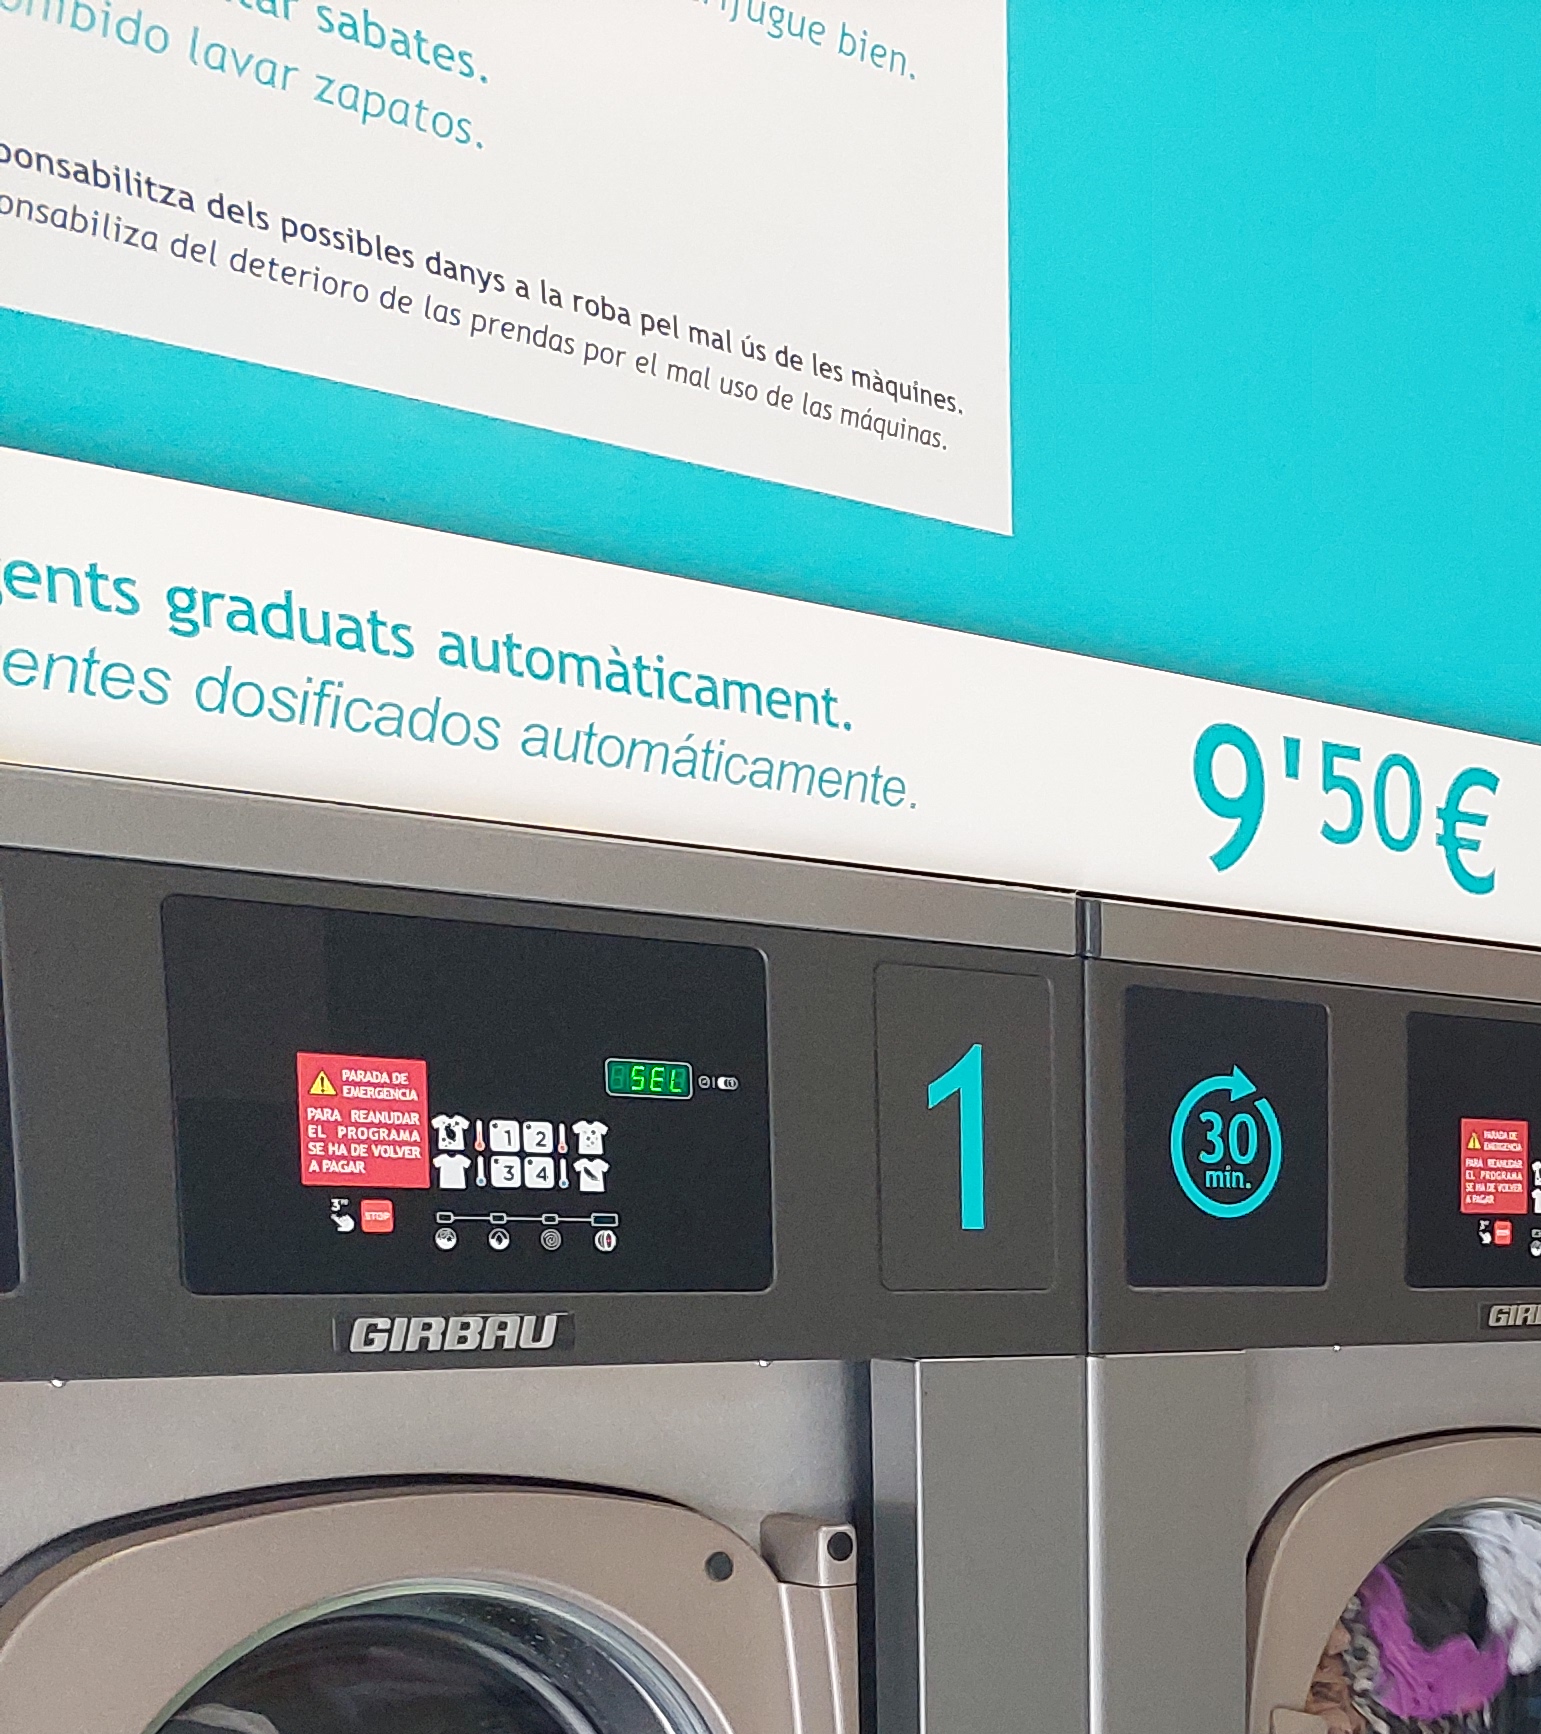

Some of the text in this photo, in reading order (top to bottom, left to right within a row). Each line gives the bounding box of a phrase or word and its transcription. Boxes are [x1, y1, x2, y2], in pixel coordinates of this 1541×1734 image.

[317, 4, 489, 83] sabates.
[838, 22, 915, 80] bien.
[190, 26, 299, 90] lavar
[314, 75, 483, 149] zapatos.
[208, 193, 269, 230] dels
[282, 217, 414, 268] possibles
[426, 252, 505, 293] danys
[516, 280, 530, 299] a
[541, 279, 563, 308] la
[574, 295, 631, 326] roba
[641, 314, 679, 339] pel
[689, 326, 731, 353] mal
[742, 335, 766, 361] ús
[776, 346, 803, 371] de
[813, 353, 842, 382] les
[852, 369, 962, 415] màquines.
[171, 234, 216, 266] del
[230, 248, 368, 302] deterioro
[380, 286, 412, 314] de
[425, 295, 460, 326] las
[470, 314, 574, 355] prendas
[584, 342, 626, 367] por
[636, 353, 656, 376] el
[667, 364, 710, 390] mal
[720, 377, 757, 401] uso
[767, 385, 793, 410] de
[803, 392, 832, 420] las
[841, 408, 946, 450] máquinas.
[0, 558, 851, 731] ents graduats automàticament.
[3, 647, 916, 809] entes dosificados automáticamente.
[1193, 722, 1501, 895] 9'50€
[342, 1070, 409, 1084] PARADA DE
[343, 1086, 418, 1101] EMERGENCIA
[630, 1066, 682, 1093] SEL
[307, 1108, 420, 1125] PARA REANUDAR
[308, 1125, 420, 1142] EL PROGRAMA
[927, 1043, 984, 1229] 1
[1199, 1112, 1257, 1164] 30
[308, 1142, 421, 1158] SE HA DE VOLVER
[309, 1160, 366, 1173] A PAGAR
[1206, 1166, 1251, 1188] min.
[350, 1313, 561, 1353] GIRBAU
